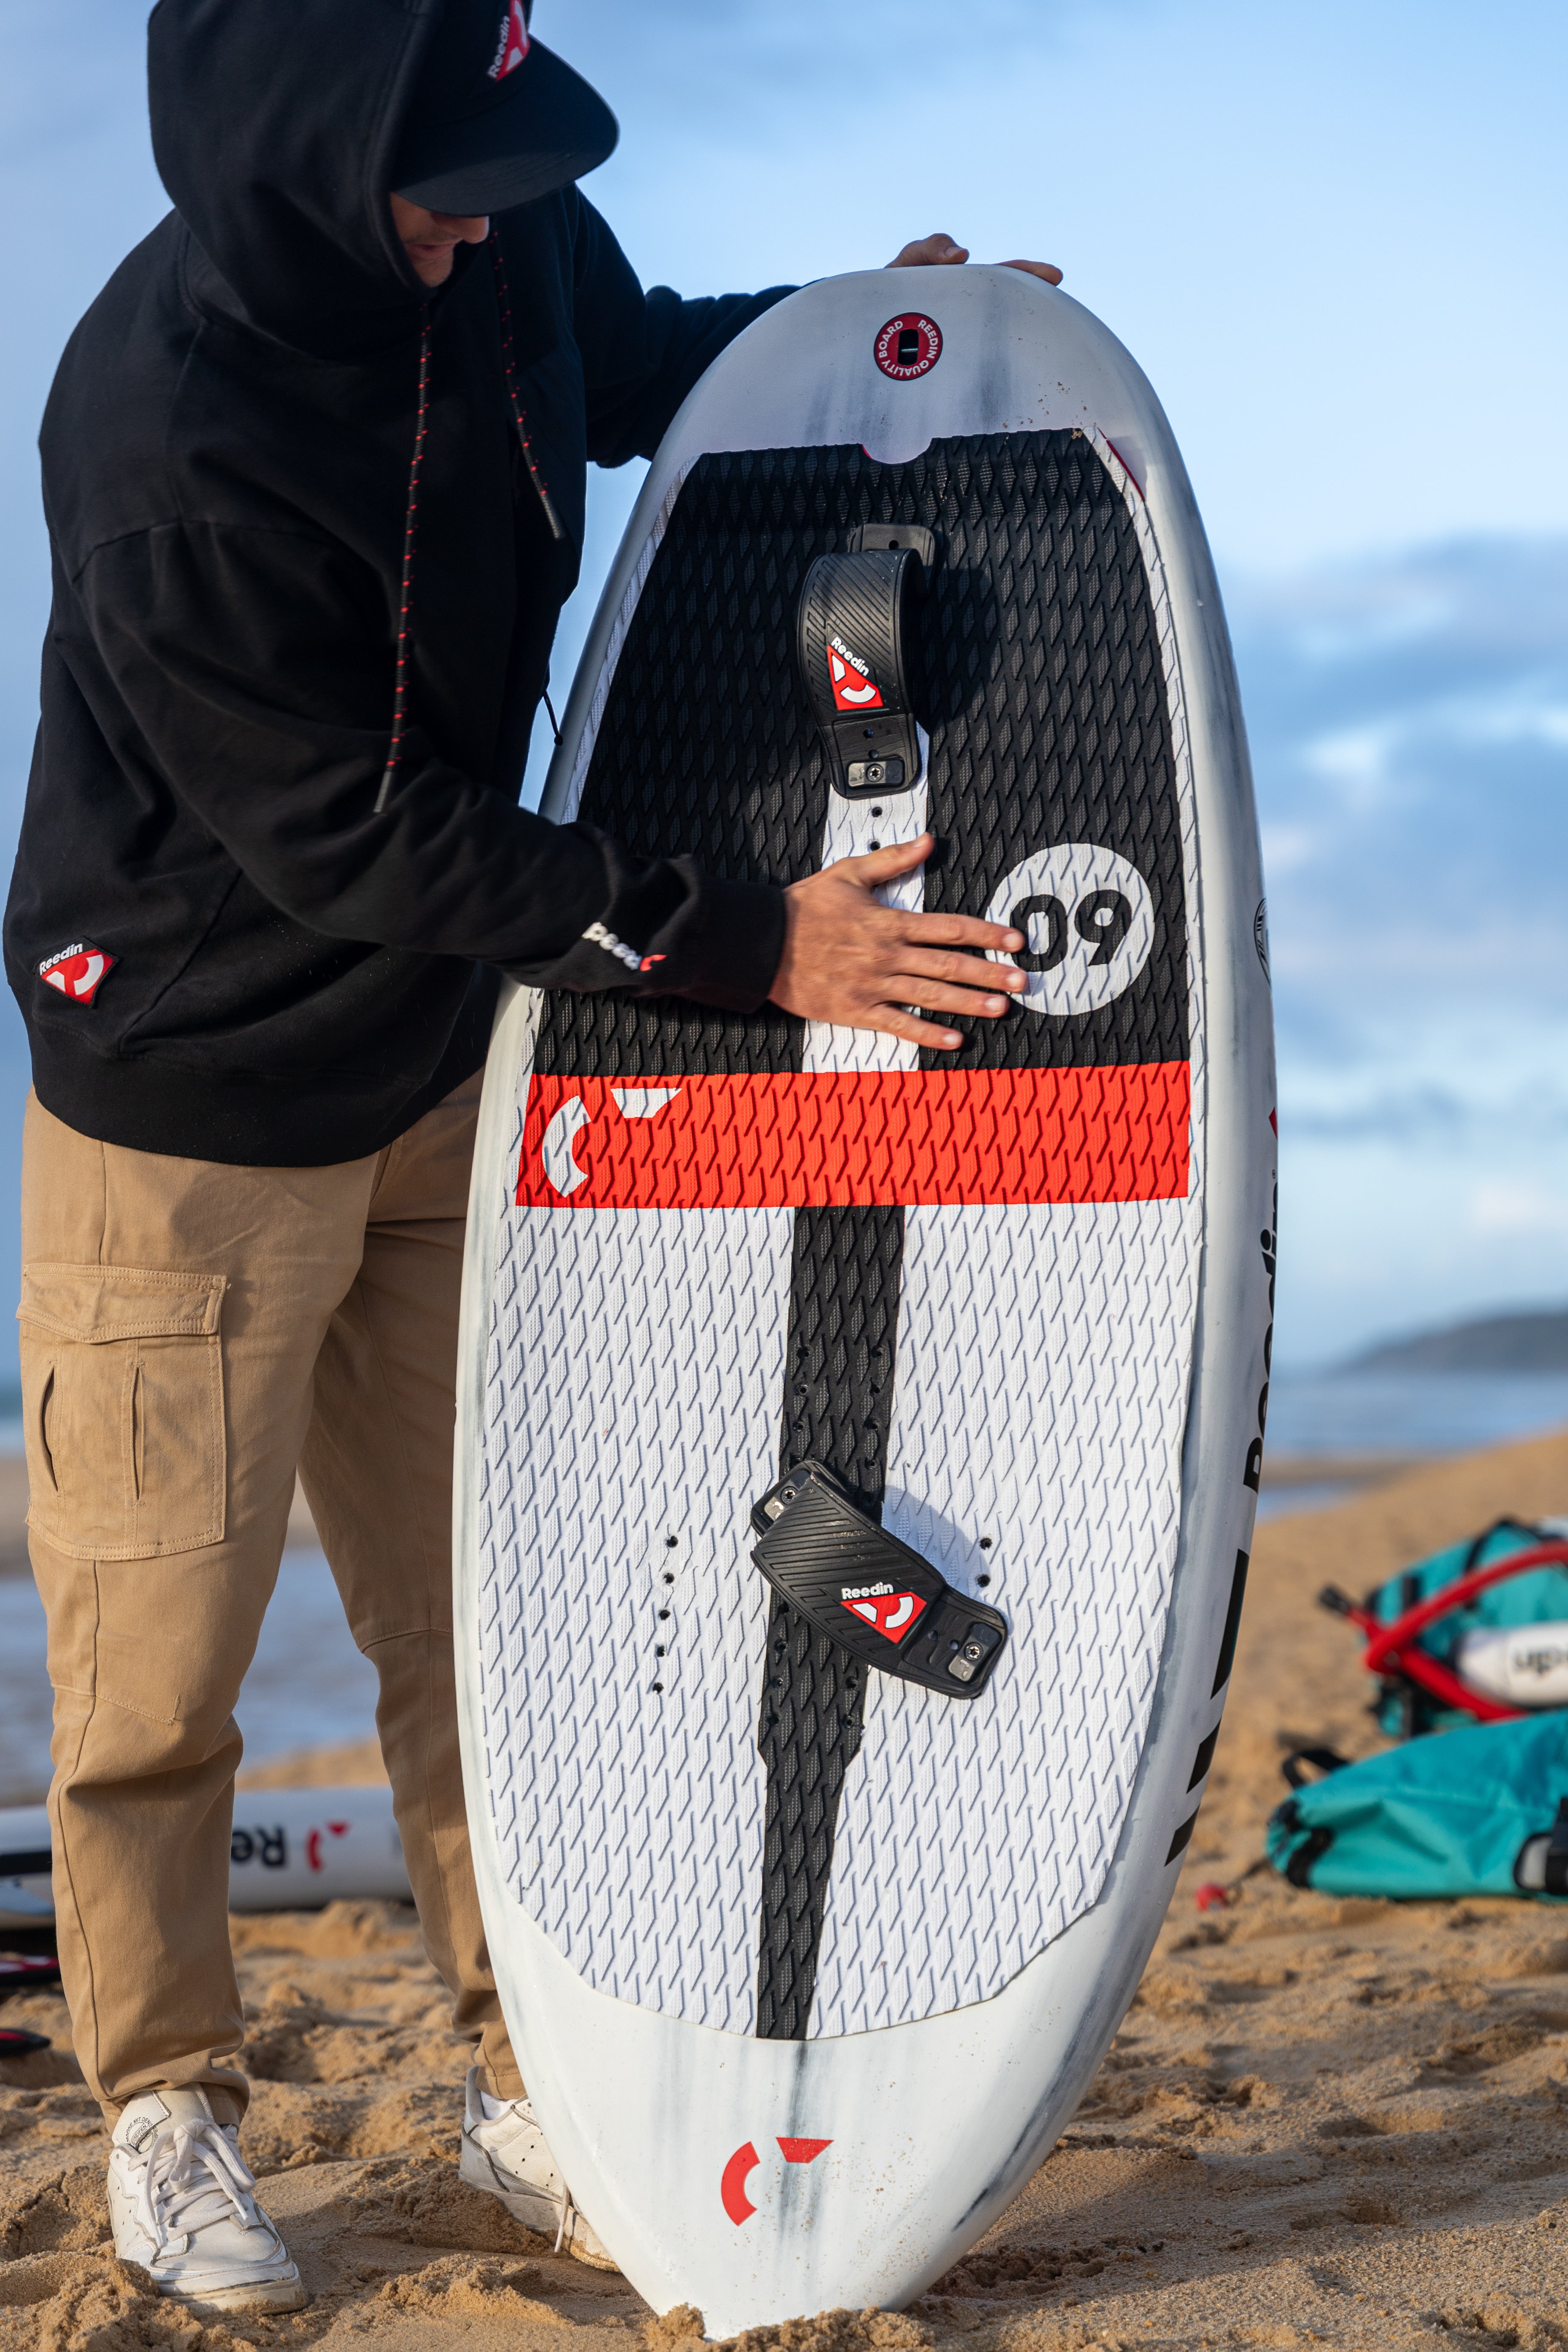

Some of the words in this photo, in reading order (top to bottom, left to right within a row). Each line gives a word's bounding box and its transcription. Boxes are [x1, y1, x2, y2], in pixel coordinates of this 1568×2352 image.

[879, 321, 903, 358] BOARD
[918, 319, 938, 358] REEDIN
[882, 360, 929, 376] QUALITY
[831, 636, 869, 676] Reedin
[39, 943, 83, 976] Reedin
[841, 1582, 893, 1600] Reedin
